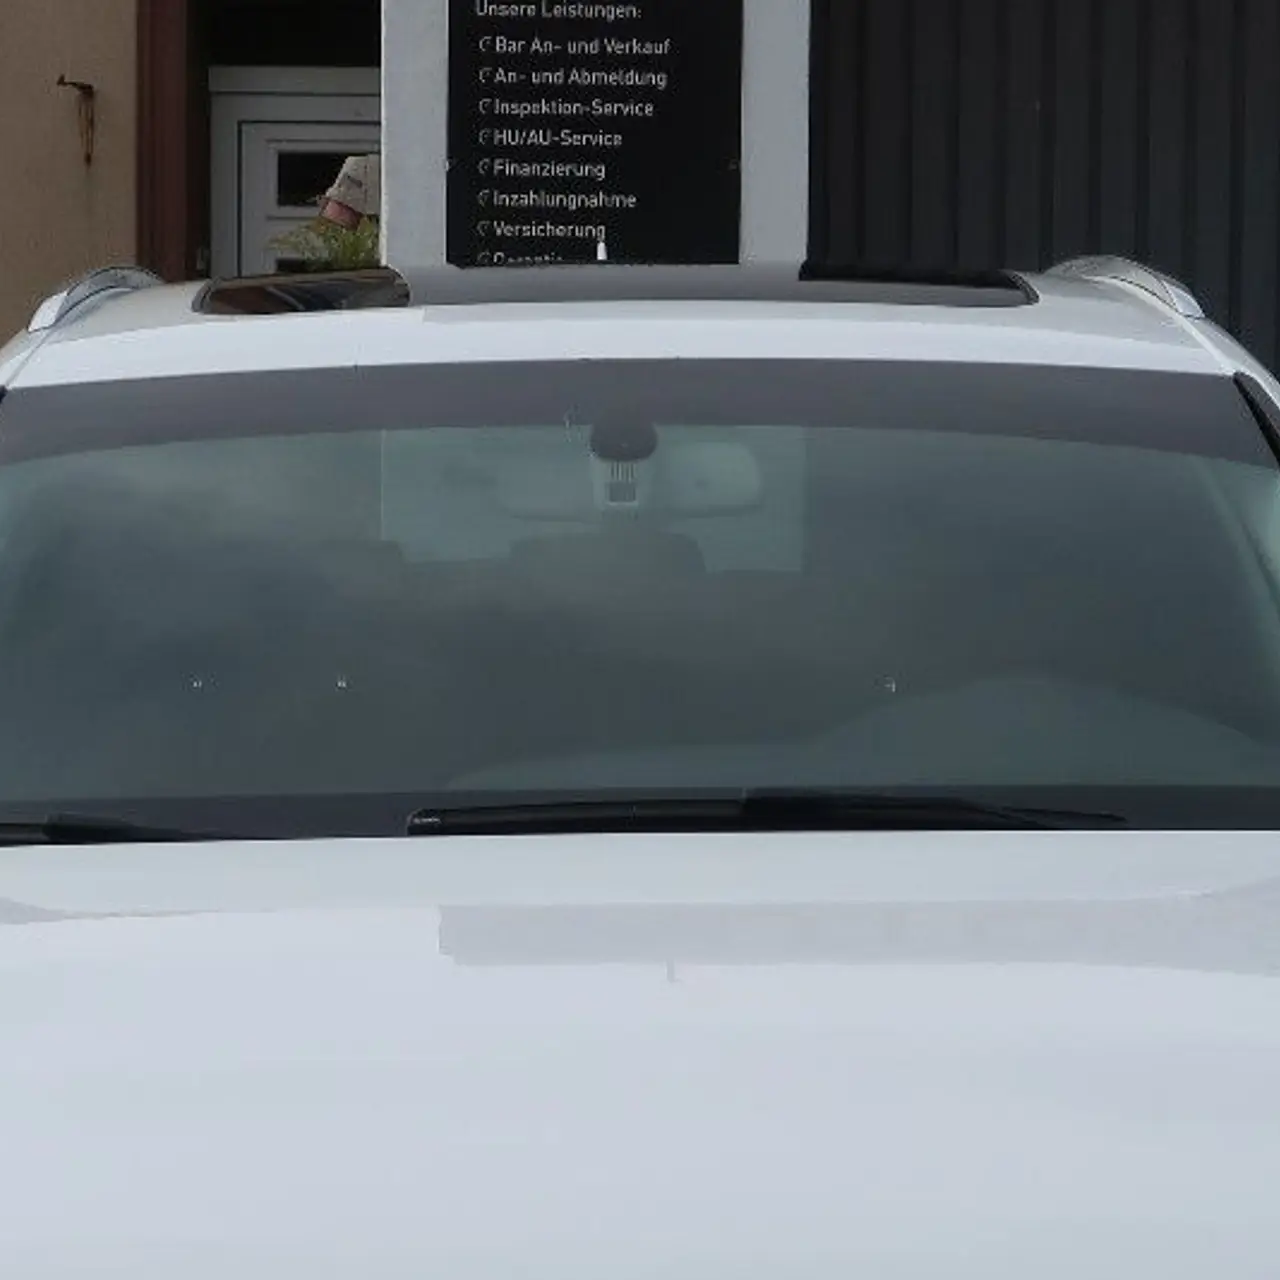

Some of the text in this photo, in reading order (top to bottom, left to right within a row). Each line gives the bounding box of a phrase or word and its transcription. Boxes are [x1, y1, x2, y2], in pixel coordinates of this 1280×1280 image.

[476, 0, 643, 22] Unsere Leistungen:
[495, 36, 671, 55] Bar An- und Verkauf
[494, 68, 668, 89] An- und Abmeldung
[494, 99, 654, 117] Inspektion-Service
[493, 129, 623, 147] HU/AU-Service
[493, 159, 606, 180] Finanzierung
[493, 190, 638, 210] Inzahlungnahme
[493, 221, 606, 241] Versicherung
